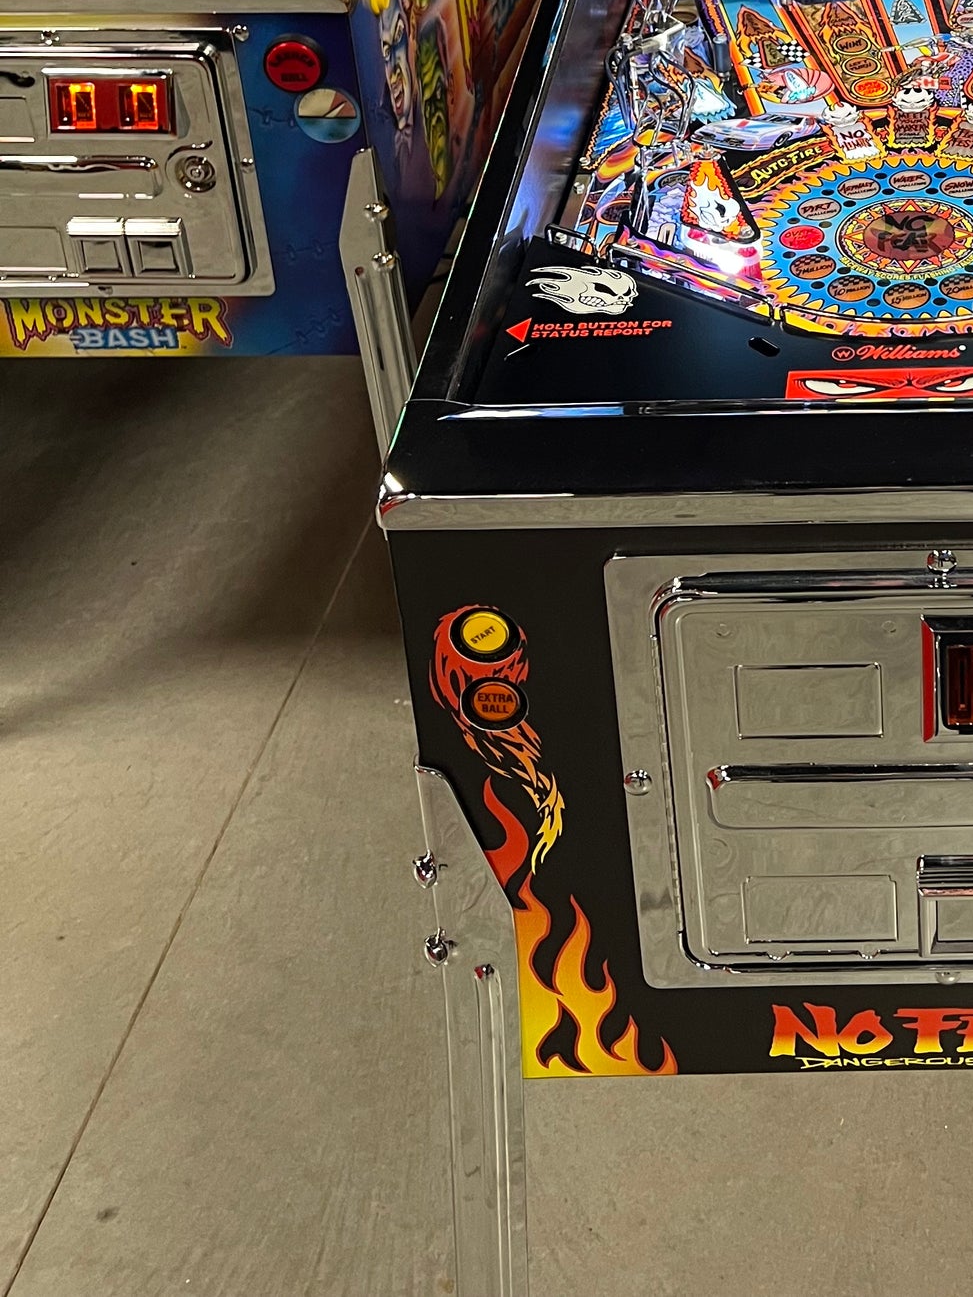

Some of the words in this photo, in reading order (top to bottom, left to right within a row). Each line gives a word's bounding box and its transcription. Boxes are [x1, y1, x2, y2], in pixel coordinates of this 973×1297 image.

[839, 130, 864, 138] NO
[801, 201, 833, 214] DIRT
[6, 298, 230, 347] MONSTER
[533, 322, 574, 332] HOLD
[577, 321, 639, 330] BUTTON
[642, 320, 673, 329] FOR
[78, 329, 178, 348] BASH
[530, 330, 590, 339] STATUS
[596, 327, 653, 337] REPORT
[856, 344, 960, 360] Williams
[470, 625, 496, 645] START
[477, 692, 514, 703] EXTRA
[481, 703, 509, 714] BALL
[769, 1003, 894, 1057] NO
